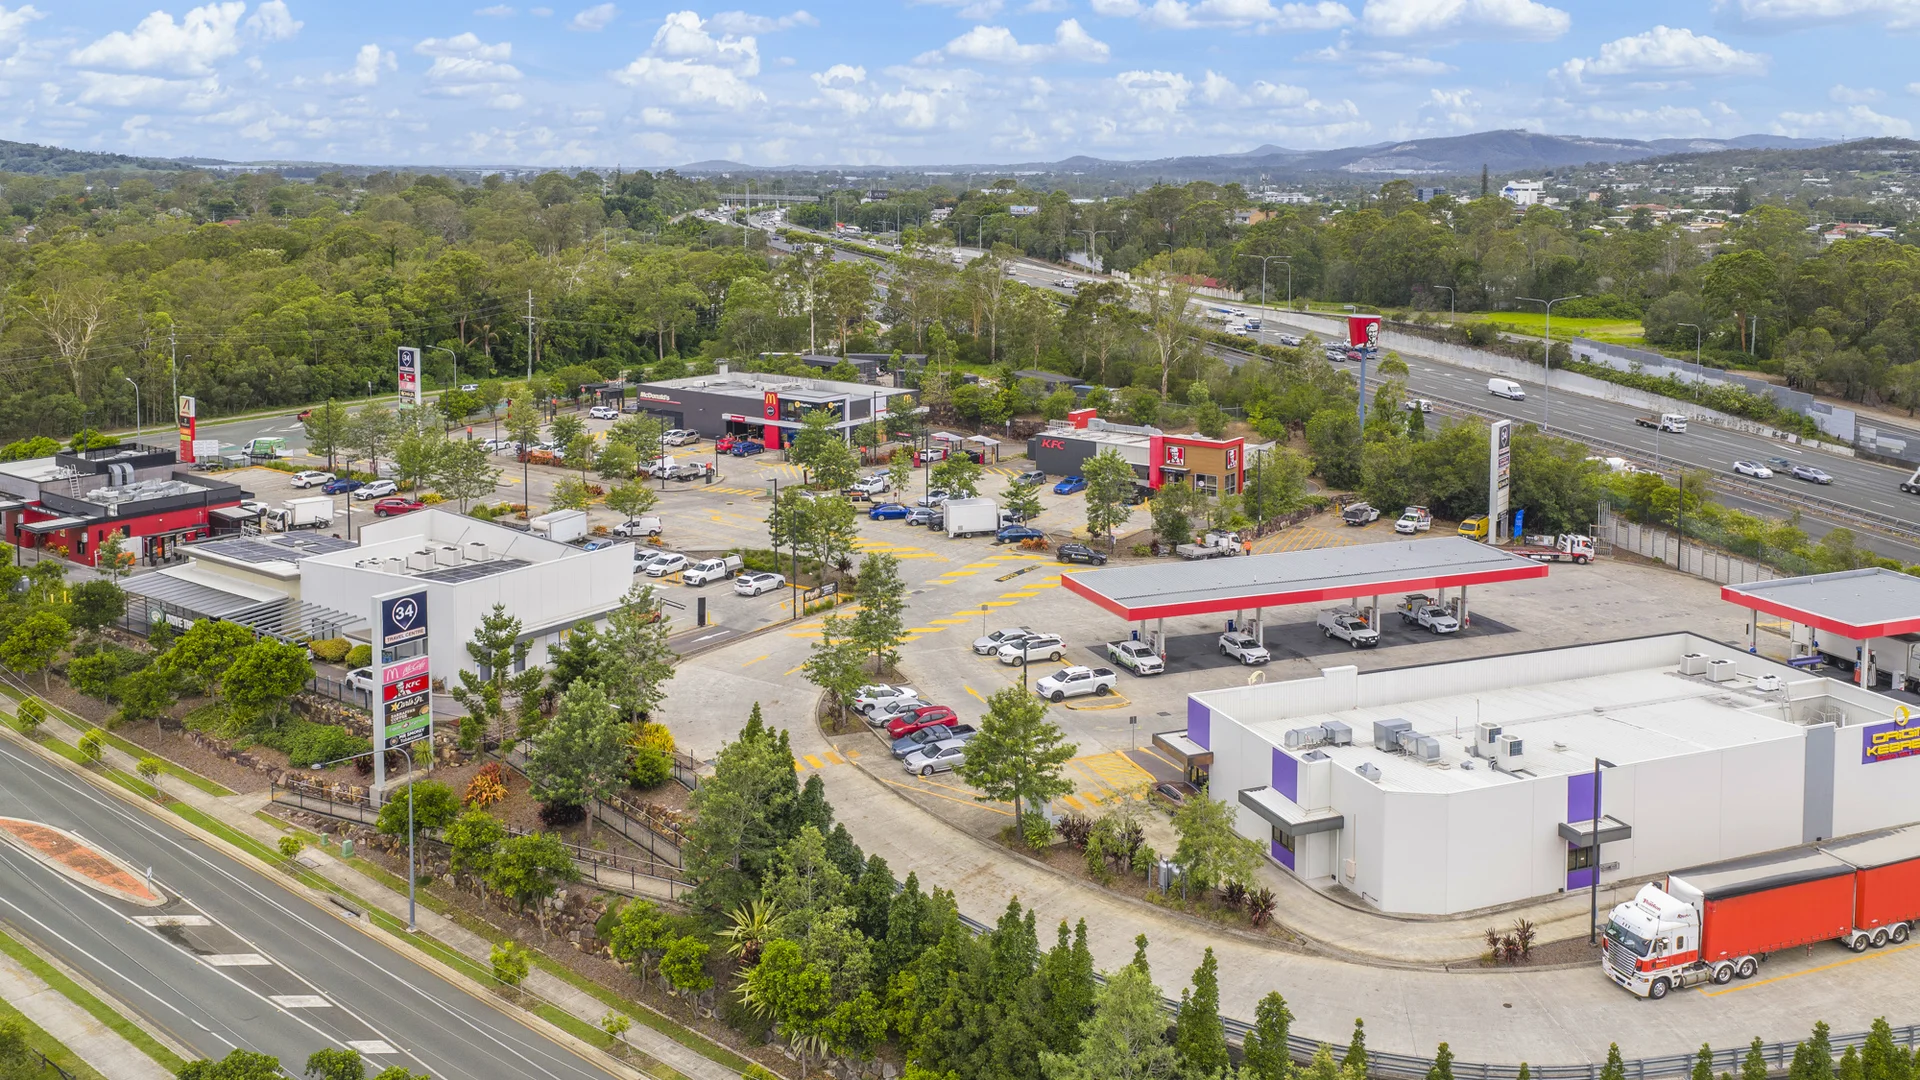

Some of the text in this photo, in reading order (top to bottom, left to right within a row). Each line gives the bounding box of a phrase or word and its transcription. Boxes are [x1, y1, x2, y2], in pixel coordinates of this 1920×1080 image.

[640, 391, 670, 401] McDonald's
[1041, 439, 1065, 450] KFC
[395, 604, 414, 620] 34
[387, 628, 424, 642] TRAVEL CENTRE
[405, 680, 421, 689] KFC
